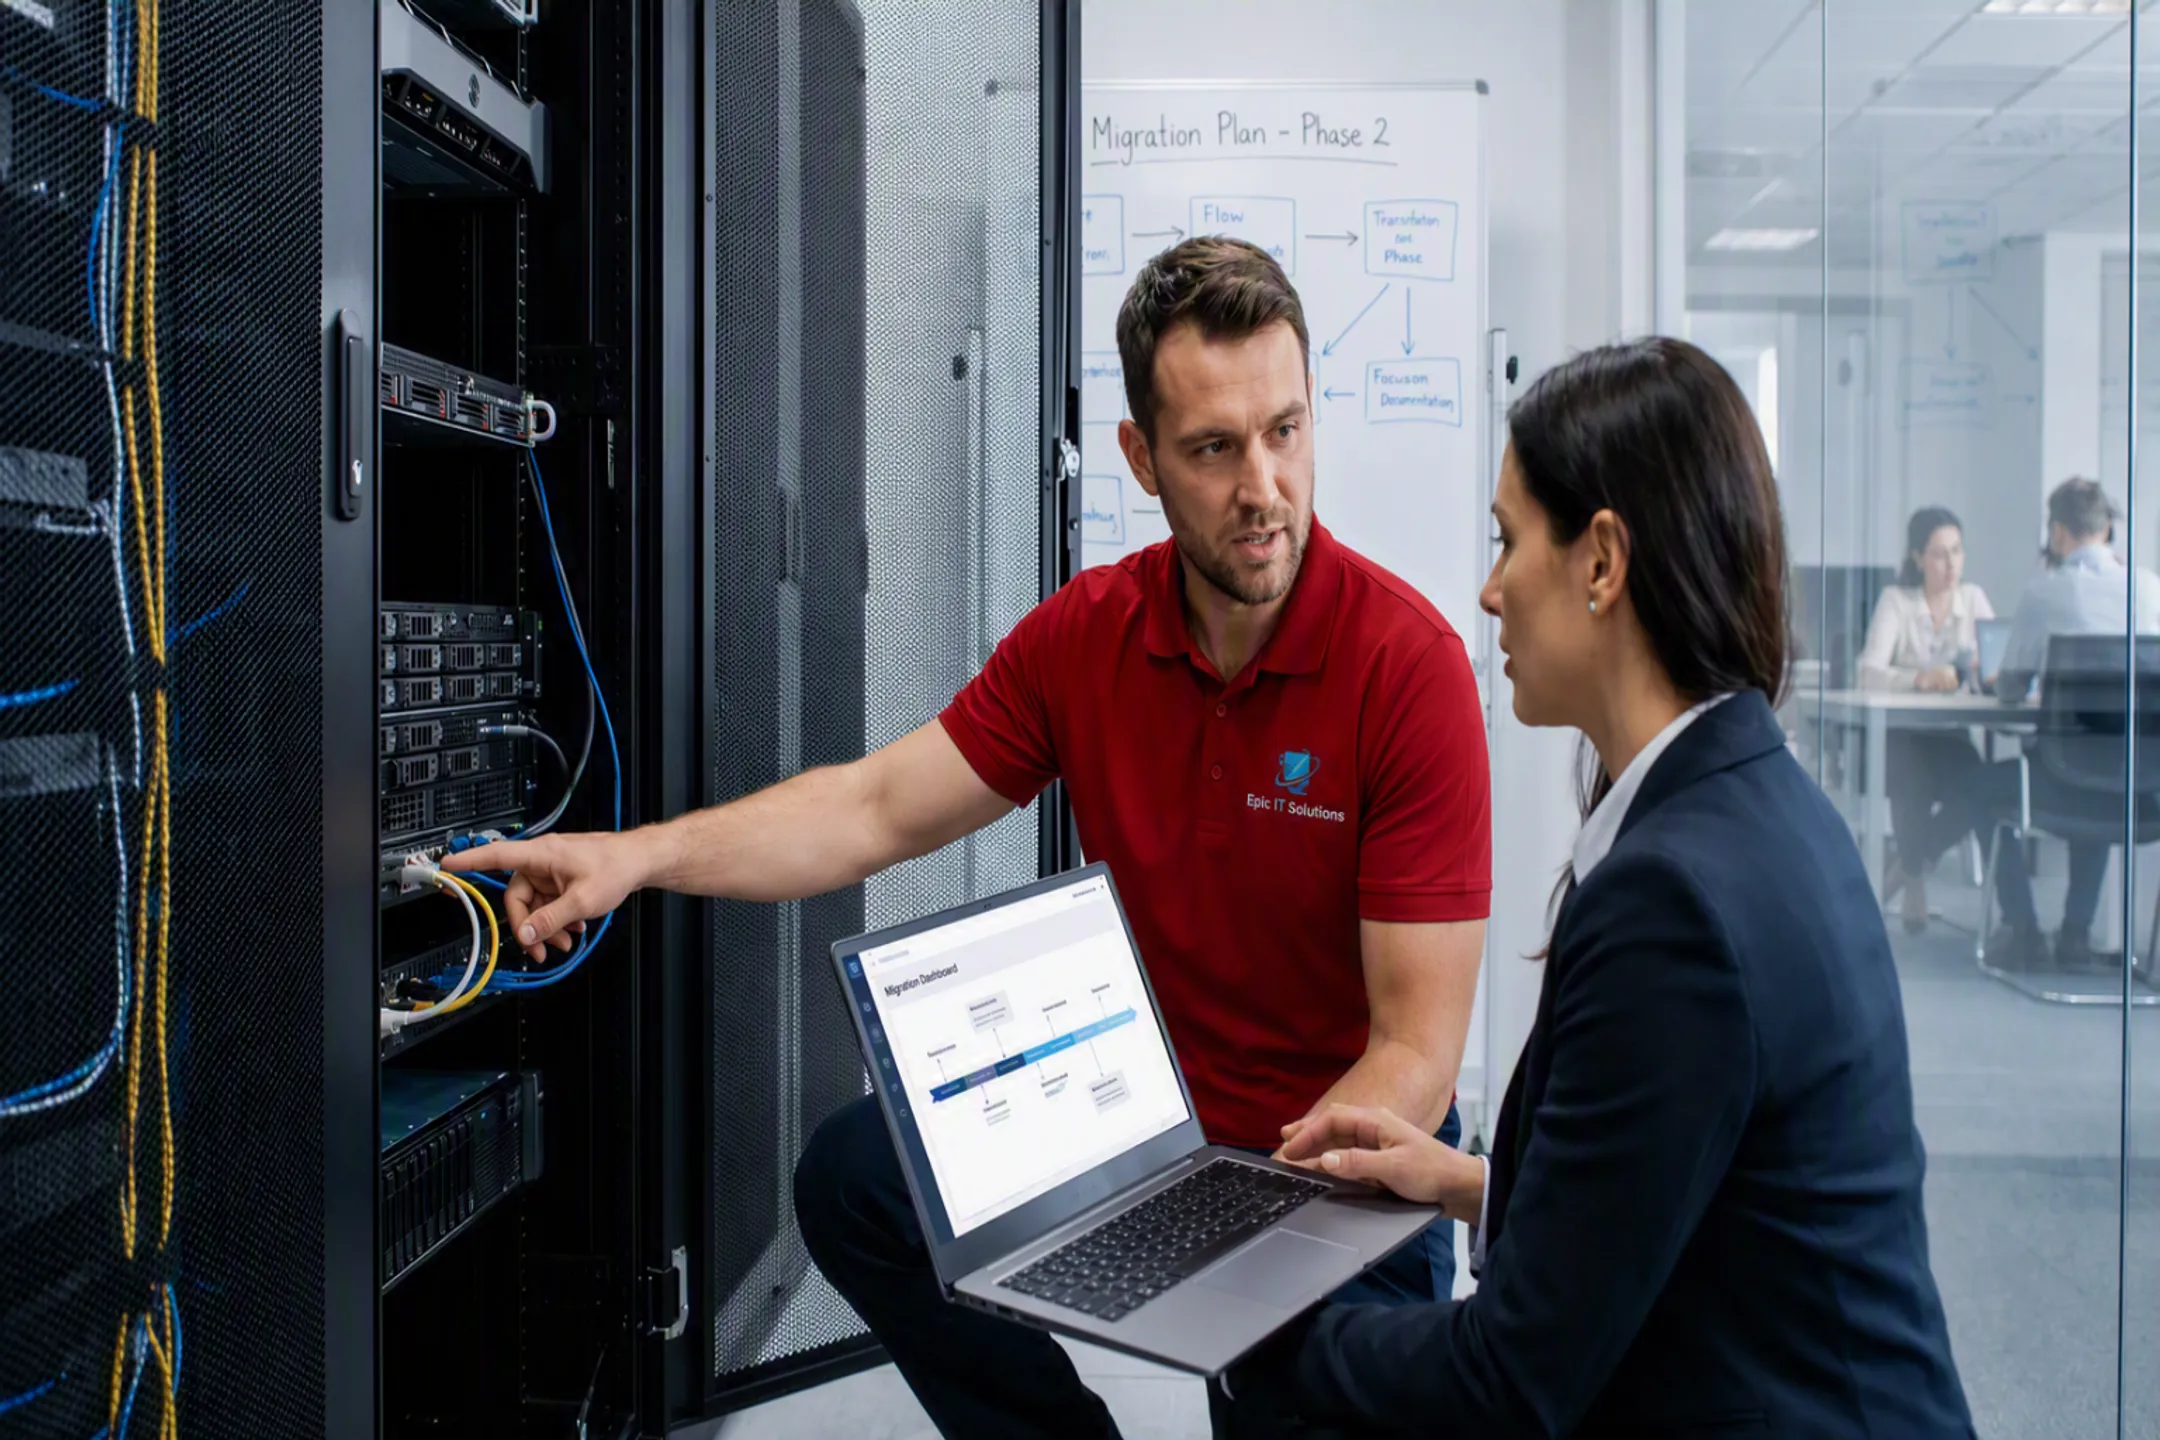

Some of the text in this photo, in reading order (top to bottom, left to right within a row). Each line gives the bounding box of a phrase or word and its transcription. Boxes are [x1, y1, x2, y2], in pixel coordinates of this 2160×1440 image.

[1092, 113, 1202, 166] Migration
[1217, 110, 1266, 145] Plan
[1302, 111, 1363, 148] Phase
[1372, 117, 1391, 147] 2
[1203, 203, 1244, 222] Flow
[1246, 793, 1345, 822] Epic IT Solutions
[884, 962, 958, 997] Migration Dashboard
